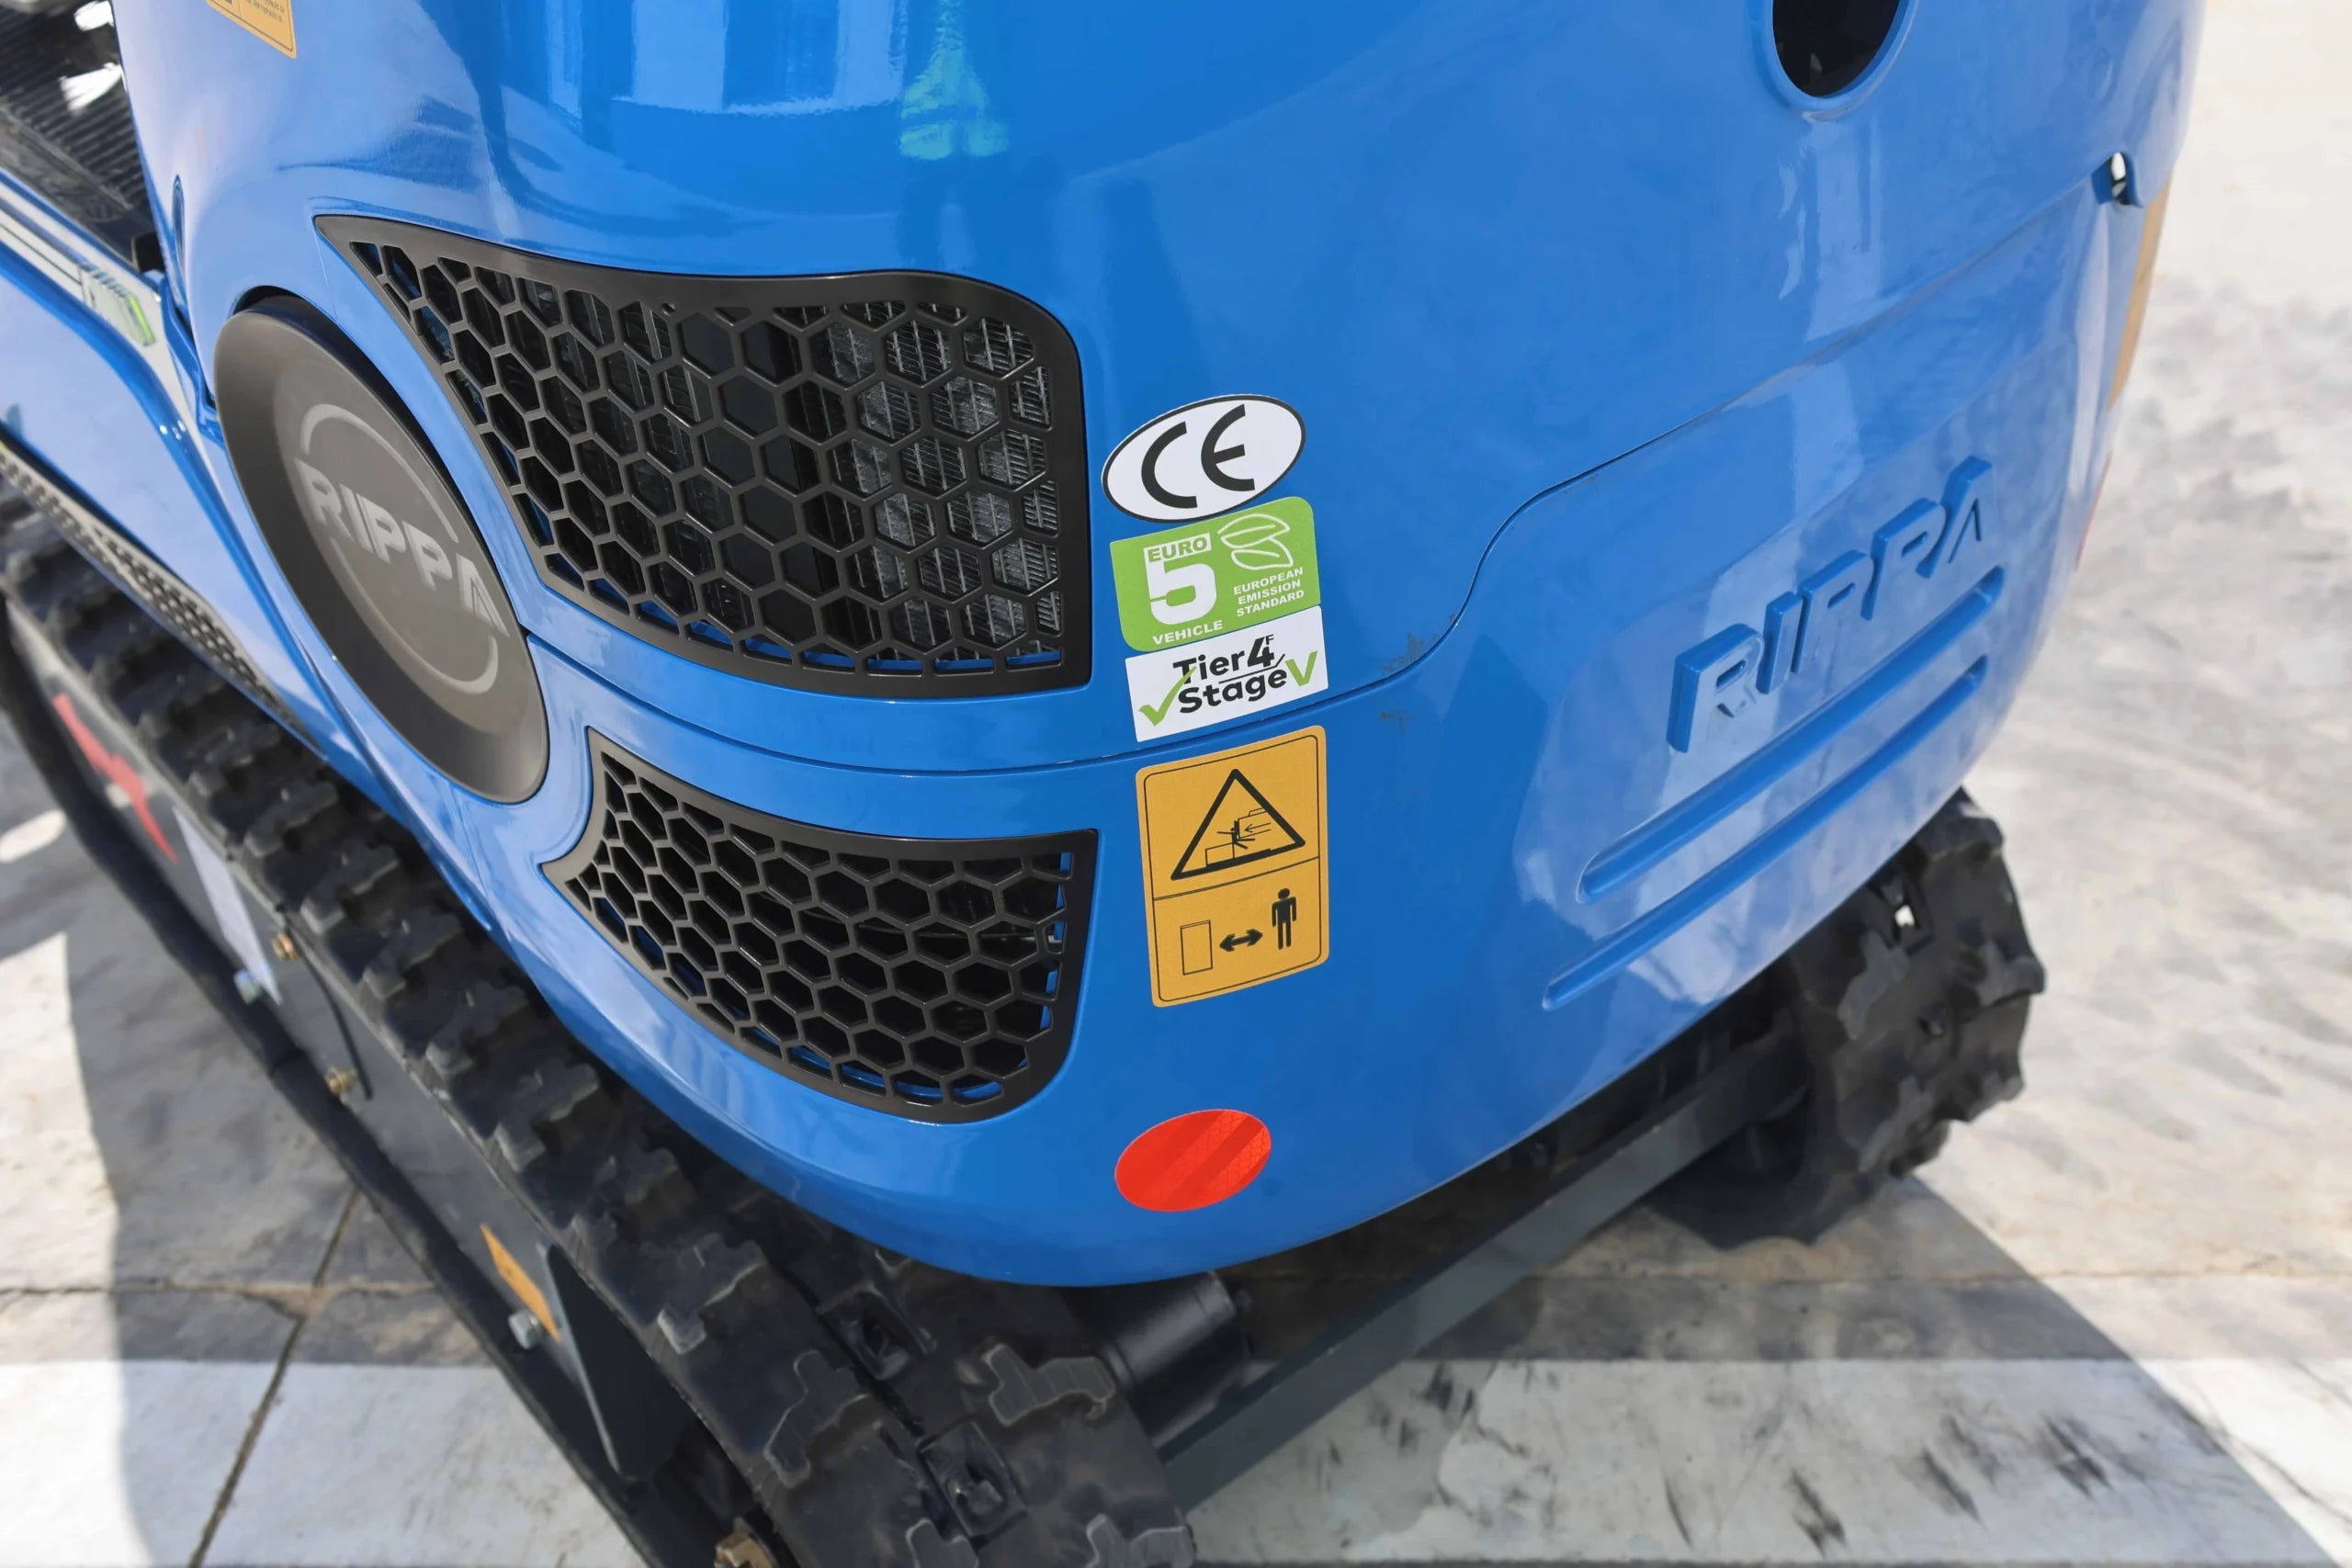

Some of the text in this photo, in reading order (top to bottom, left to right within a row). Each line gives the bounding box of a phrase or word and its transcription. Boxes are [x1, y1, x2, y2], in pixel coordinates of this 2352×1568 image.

[1140, 403, 1256, 509] CE
[293, 457, 511, 637] RIPPA
[1148, 534, 1209, 563] EURO
[1146, 552, 1217, 625] 5
[1233, 567, 1304, 595] EUROPEAN
[1238, 579, 1301, 605] EMISSION
[1237, 590, 1305, 617] STANDARD
[1665, 455, 2001, 755] RIPPA
[1152, 620, 1224, 646] VEHICLE
